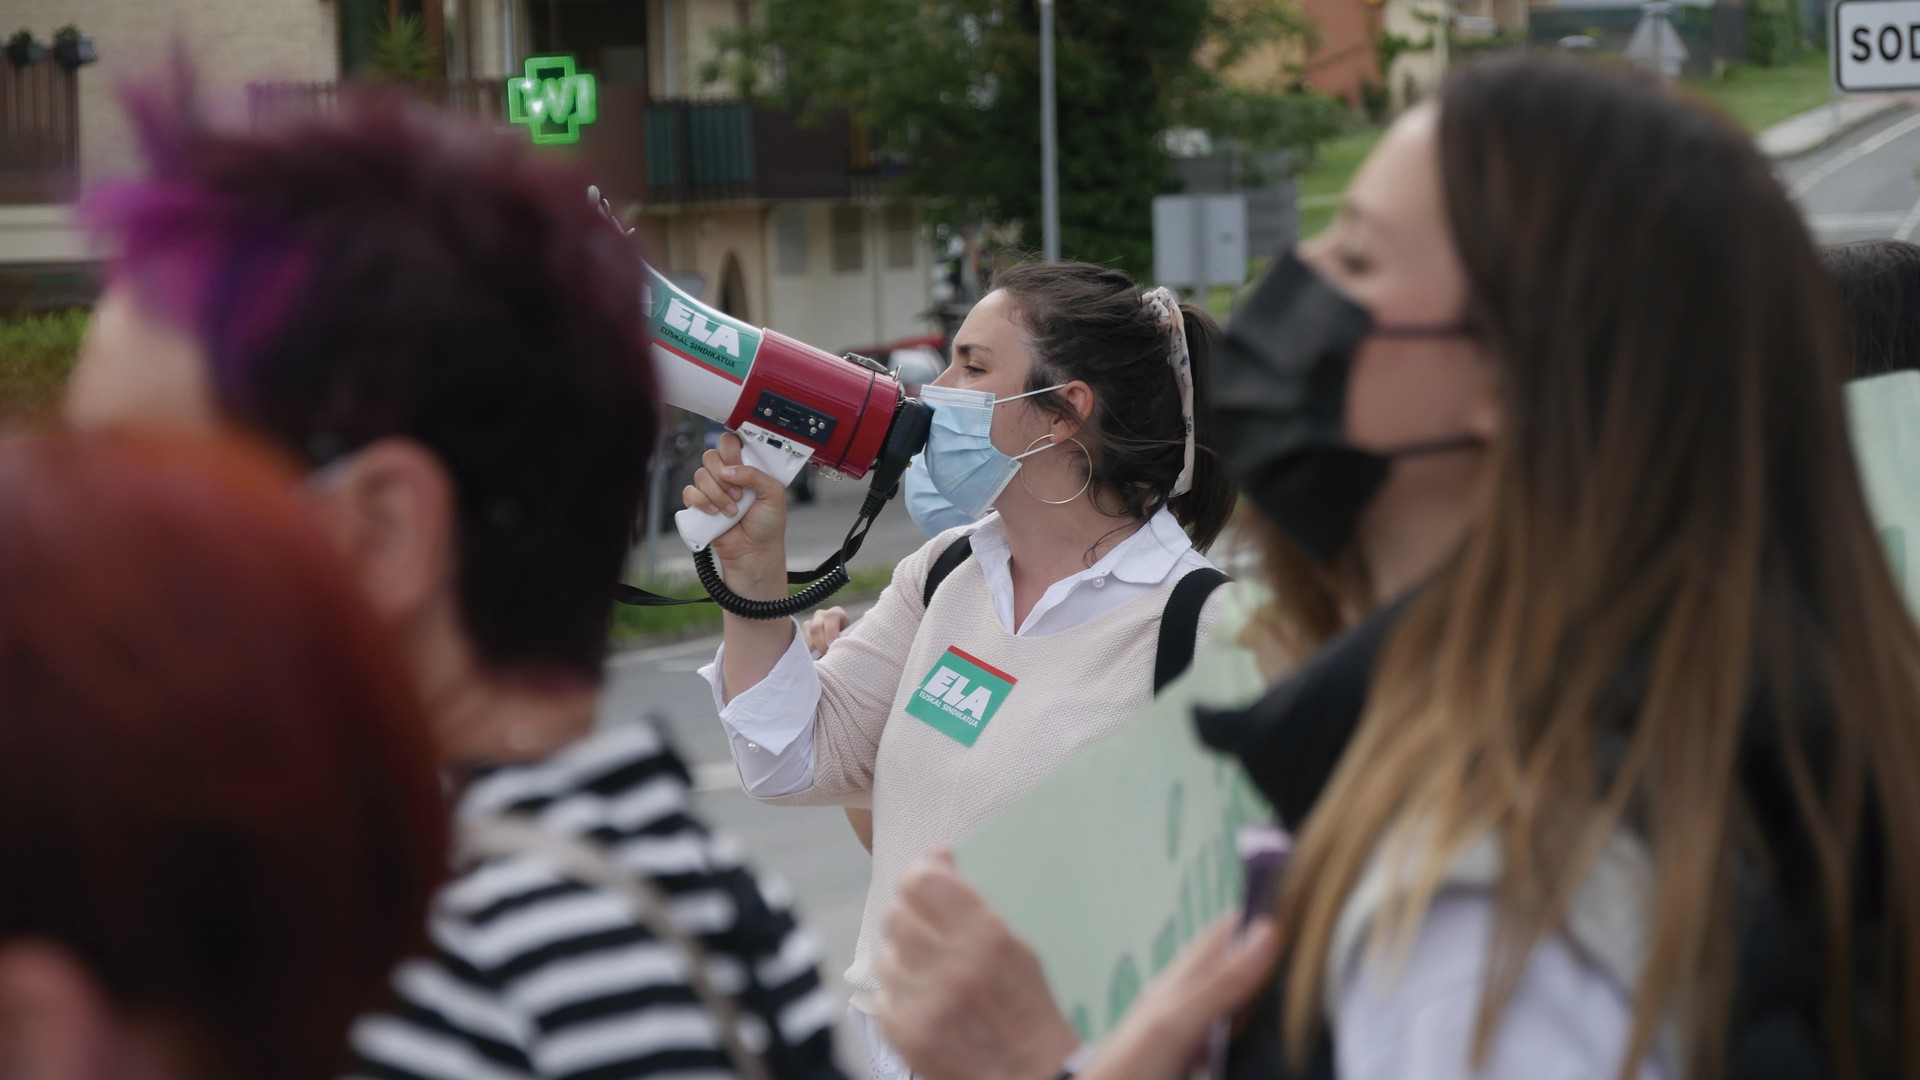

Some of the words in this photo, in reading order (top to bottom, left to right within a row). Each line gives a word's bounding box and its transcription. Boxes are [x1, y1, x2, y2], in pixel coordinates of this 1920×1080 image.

[660, 326, 688, 346] EUSKAL
[689, 342, 736, 368] SINDIKATUA
[664, 297, 740, 358] ELA
[918, 691, 943, 708] EUSKAL
[942, 703, 978, 727] SINDIKATUA
[922, 665, 992, 721] ELA
